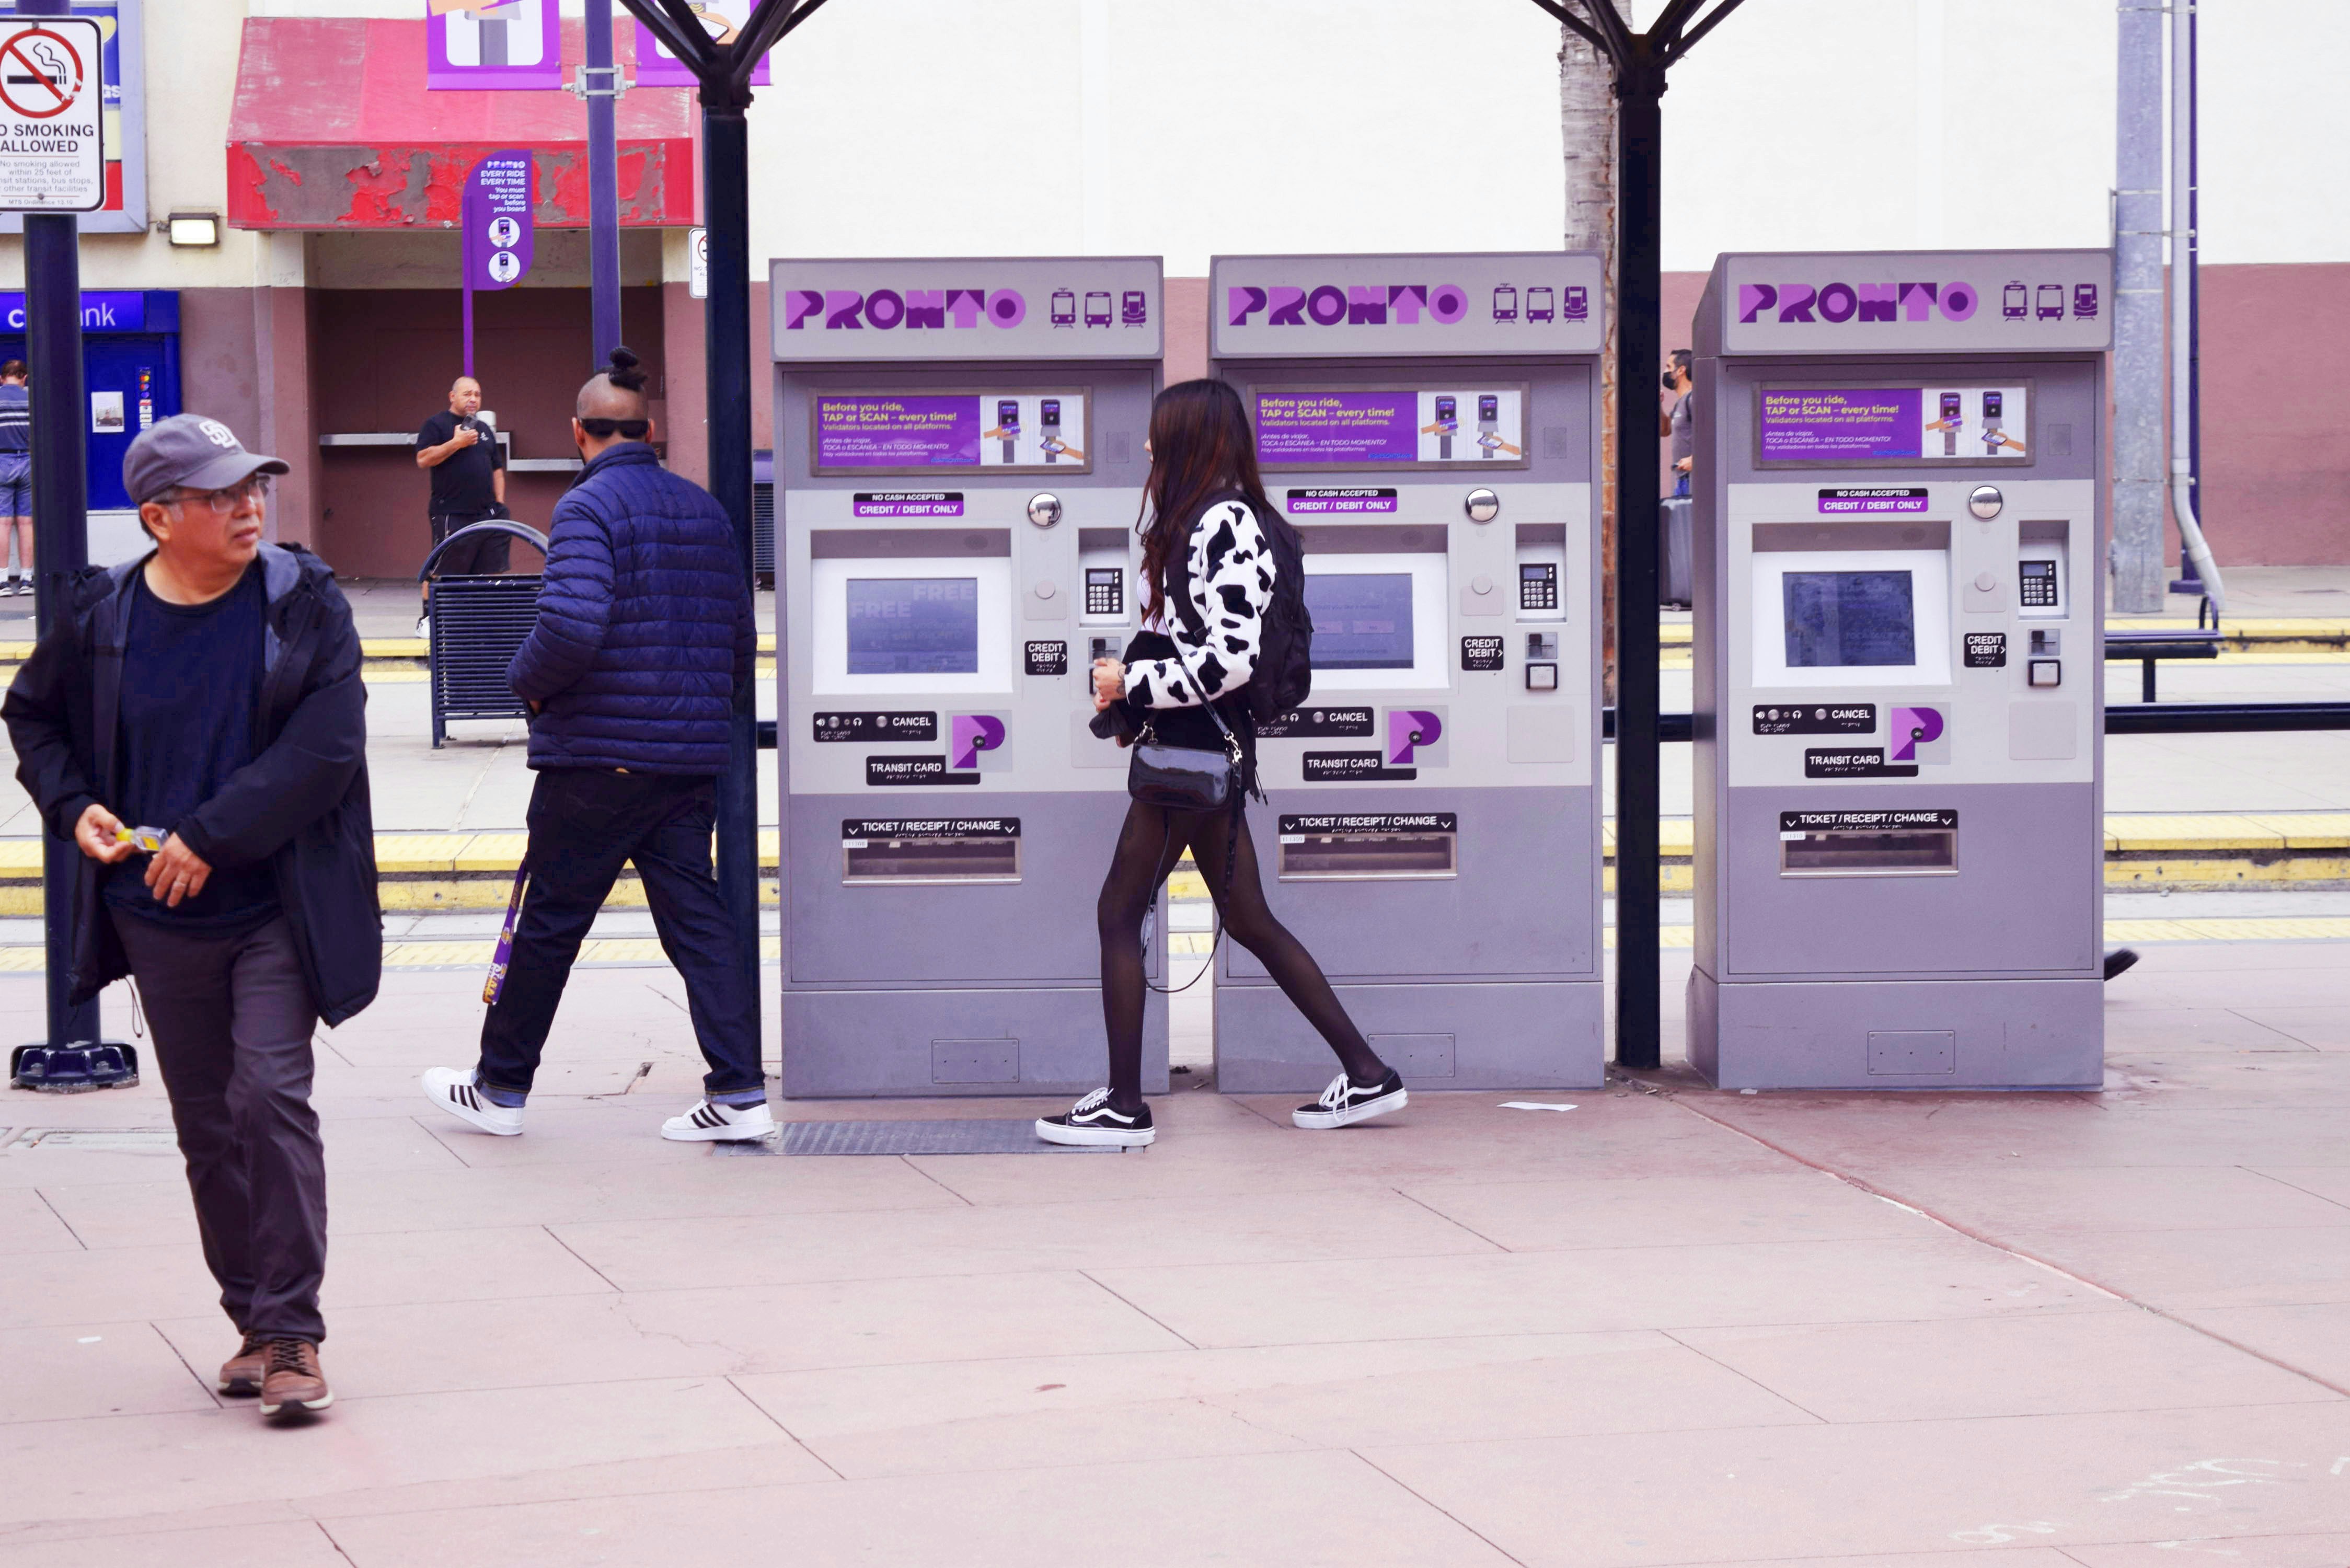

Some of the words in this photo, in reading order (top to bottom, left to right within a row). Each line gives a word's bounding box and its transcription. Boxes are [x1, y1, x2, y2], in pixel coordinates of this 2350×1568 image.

[14, 124, 94, 136] SMOKING
[1, 140, 78, 152] ALLOWED
[1228, 284, 1468, 326] PRONTO
[1739, 282, 1978, 323] PRONTO
[786, 289, 1026, 330] PRONTO
[1298, 400, 1316, 409] you
[1320, 398, 1342, 408] ride,
[1803, 398, 1821, 406] you
[1824, 396, 1847, 405] ride,
[823, 403, 857, 411] Before
[860, 405, 879, 413] you
[882, 403, 904, 412] ride,
[1766, 407, 1787, 415] TAP
[1841, 407, 1869, 416] every
[1872, 406, 1899, 414] time!
[860, 413, 888, 422] SCAN
[898, 414, 927, 423] every
[930, 412, 957, 421] time!
[1261, 409, 1280, 418] TAP
[1298, 409, 1326, 418] SCAN
[1337, 410, 1365, 419] every
[1368, 408, 1394, 417] time!
[859, 505, 894, 514] CREDIT
[903, 505, 931, 513] DEBIT
[1293, 502, 1328, 510] CREDIT
[1336, 501, 1364, 510] DEBIT
[1366, 501, 1391, 509] ONLY
[1824, 502, 1859, 510] CREDIT
[1867, 501, 1895, 510] DEBIT
[1897, 501, 1922, 509] ONLY
[913, 584, 974, 601] FREE
[851, 602, 912, 618] FREE
[1465, 639, 1500, 649] CREDIT
[1967, 636, 2002, 646] CREDIT
[1029, 643, 1063, 652] CREDIT
[1971, 645, 1998, 654] DEBIT
[1032, 653, 1059, 662] DEBIT
[1469, 649, 1496, 657] DEBIT
[1330, 713, 1367, 721] CANCEL
[1832, 710, 1870, 718] CANCEL
[893, 717, 931, 726] CANCEL
[1307, 759, 1349, 768] TRANSIT
[1351, 759, 1378, 767] CARD
[1810, 756, 1851, 765] TRANSIT
[1852, 755, 1880, 764] CARD
[871, 763, 913, 772] TRANSIT
[914, 763, 941, 772] CARD
[1298, 817, 1336, 827] TICKET
[1343, 816, 1386, 826] RECEIPT
[1393, 816, 1437, 825] CHANGE
[1800, 814, 1837, 824] TICKET
[1844, 814, 1887, 823] RECEIPT
[1894, 813, 1938, 822] CHANGE
[862, 822, 899, 832] TICKET
[907, 821, 950, 831] RECEIPT
[957, 821, 1001, 830] CHANGE
